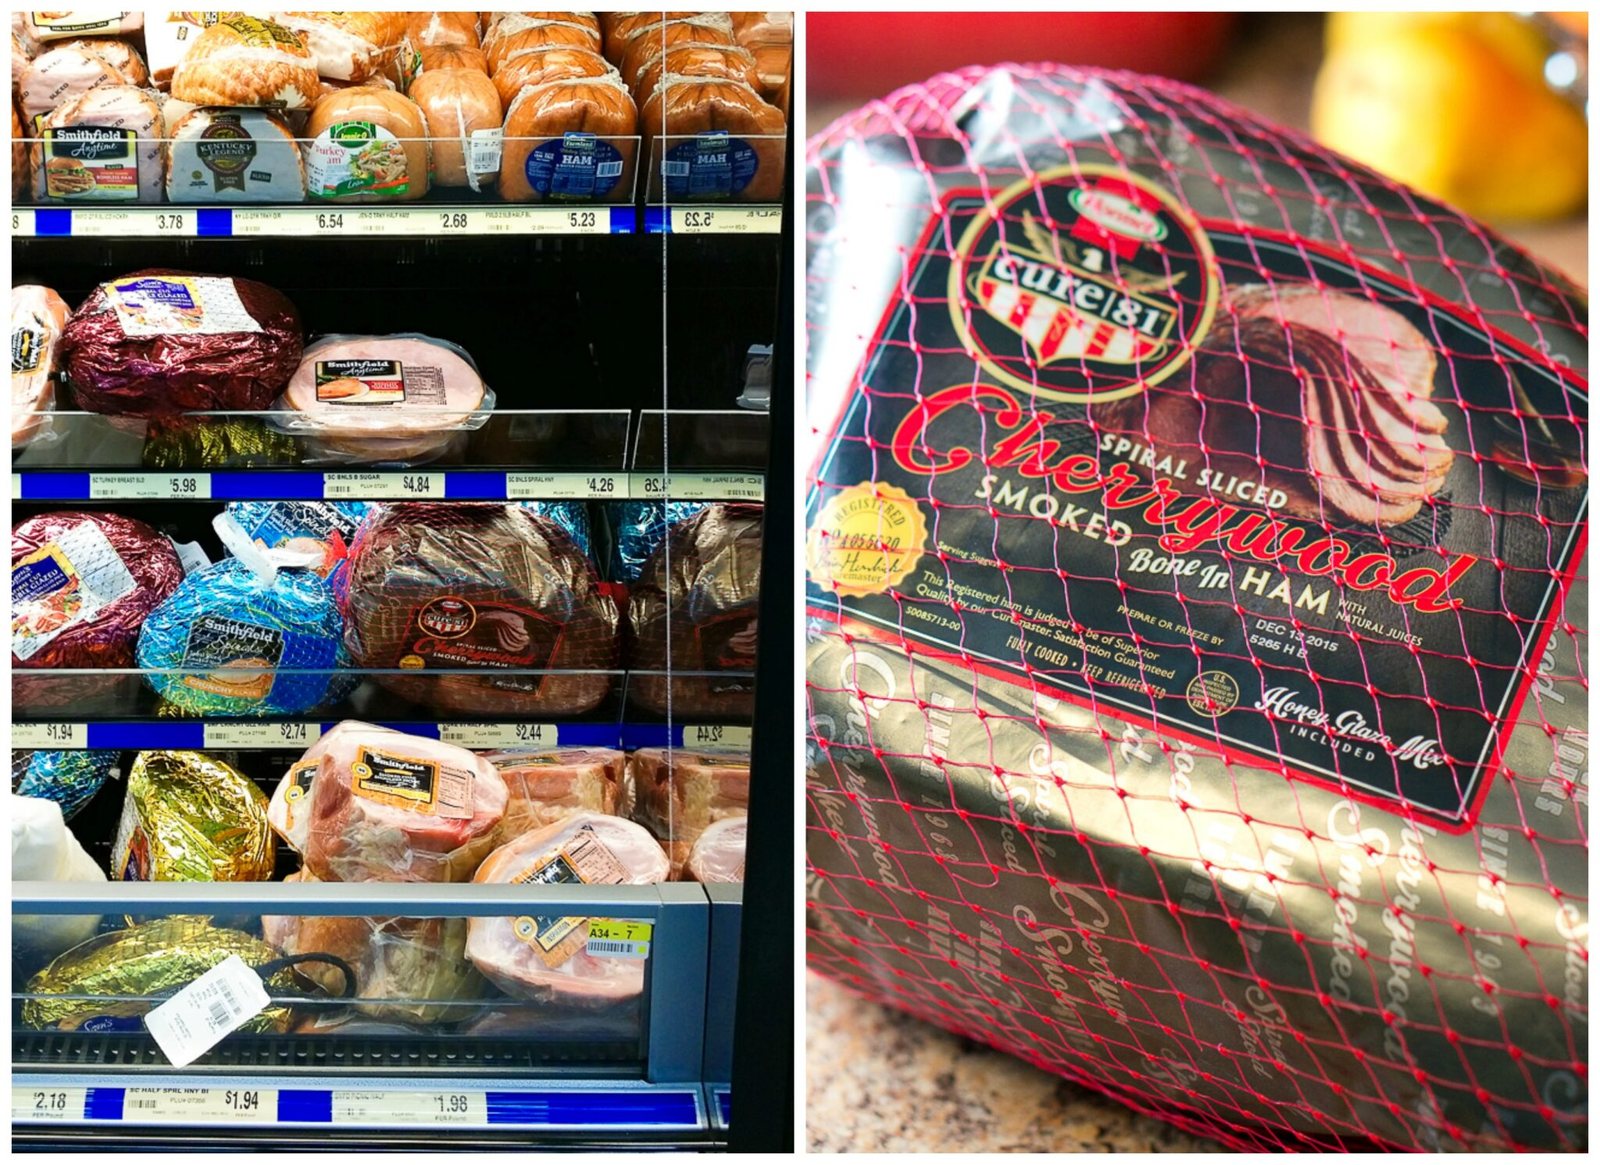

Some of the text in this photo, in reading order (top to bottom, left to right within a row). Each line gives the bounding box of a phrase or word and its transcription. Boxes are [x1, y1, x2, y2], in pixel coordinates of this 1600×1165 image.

[56, 129, 121, 144] Smithfield
[200, 141, 253, 153] KENTUCKY
[561, 155, 593, 165] HAM
[327, 361, 390, 370] Smithfield
[1099, 433, 1289, 511] SPIRAL SLICED
[169, 478, 197, 493] $5.98
[403, 475, 430, 493] $4.84
[586, 477, 615, 493] $4.26
[891, 383, 1479, 613] Cherrywood
[835, 497, 907, 527] REGISTERED
[937, 541, 970, 561] Serving
[974, 474, 1333, 617] SMOKED Bone In HAM
[924, 570, 1162, 662] This Registered ham is judged be of Superior
[1338, 597, 1368, 617] WITH
[204, 618, 274, 643] Smithfield
[916, 583, 955, 608] Quality
[969, 603, 989, 617] our
[1052, 629, 1112, 661] Satisfaction
[1113, 651, 1177, 681] Guaranteed
[1117, 604, 1225, 647] PREPARE OR FREEZE BY
[1254, 618, 1287, 637] DEC
[1304, 633, 1340, 653] 2015
[1335, 611, 1425, 648] NATURAL JUICES
[412, 637, 537, 666] Cherrywood
[1248, 633, 1282, 652] 5265
[1283, 643, 1296, 656] H
[432, 652, 467, 662] SMOKED
[1005, 635, 1035, 654] FULLY
[1033, 645, 1070, 668] COOKED
[1079, 662, 1104, 679] KEEP
[1104, 670, 1167, 701] REFRIGERTED
[47, 722, 73, 740] $1.94
[281, 723, 307, 740] $2.74
[516, 723, 542, 741] $2.44
[1253, 686, 1330, 727] Honey
[1330, 709, 1392, 746] Glaze
[1388, 734, 1446, 770] Mix
[1289, 724, 1377, 763] INCLUDED
[372, 754, 426, 771] Smithfield
[589, 928, 609, 939] A34
[626, 930, 633, 939] 7
[33, 1092, 67, 1111] $2.18
[225, 1090, 259, 1110] $1.94
